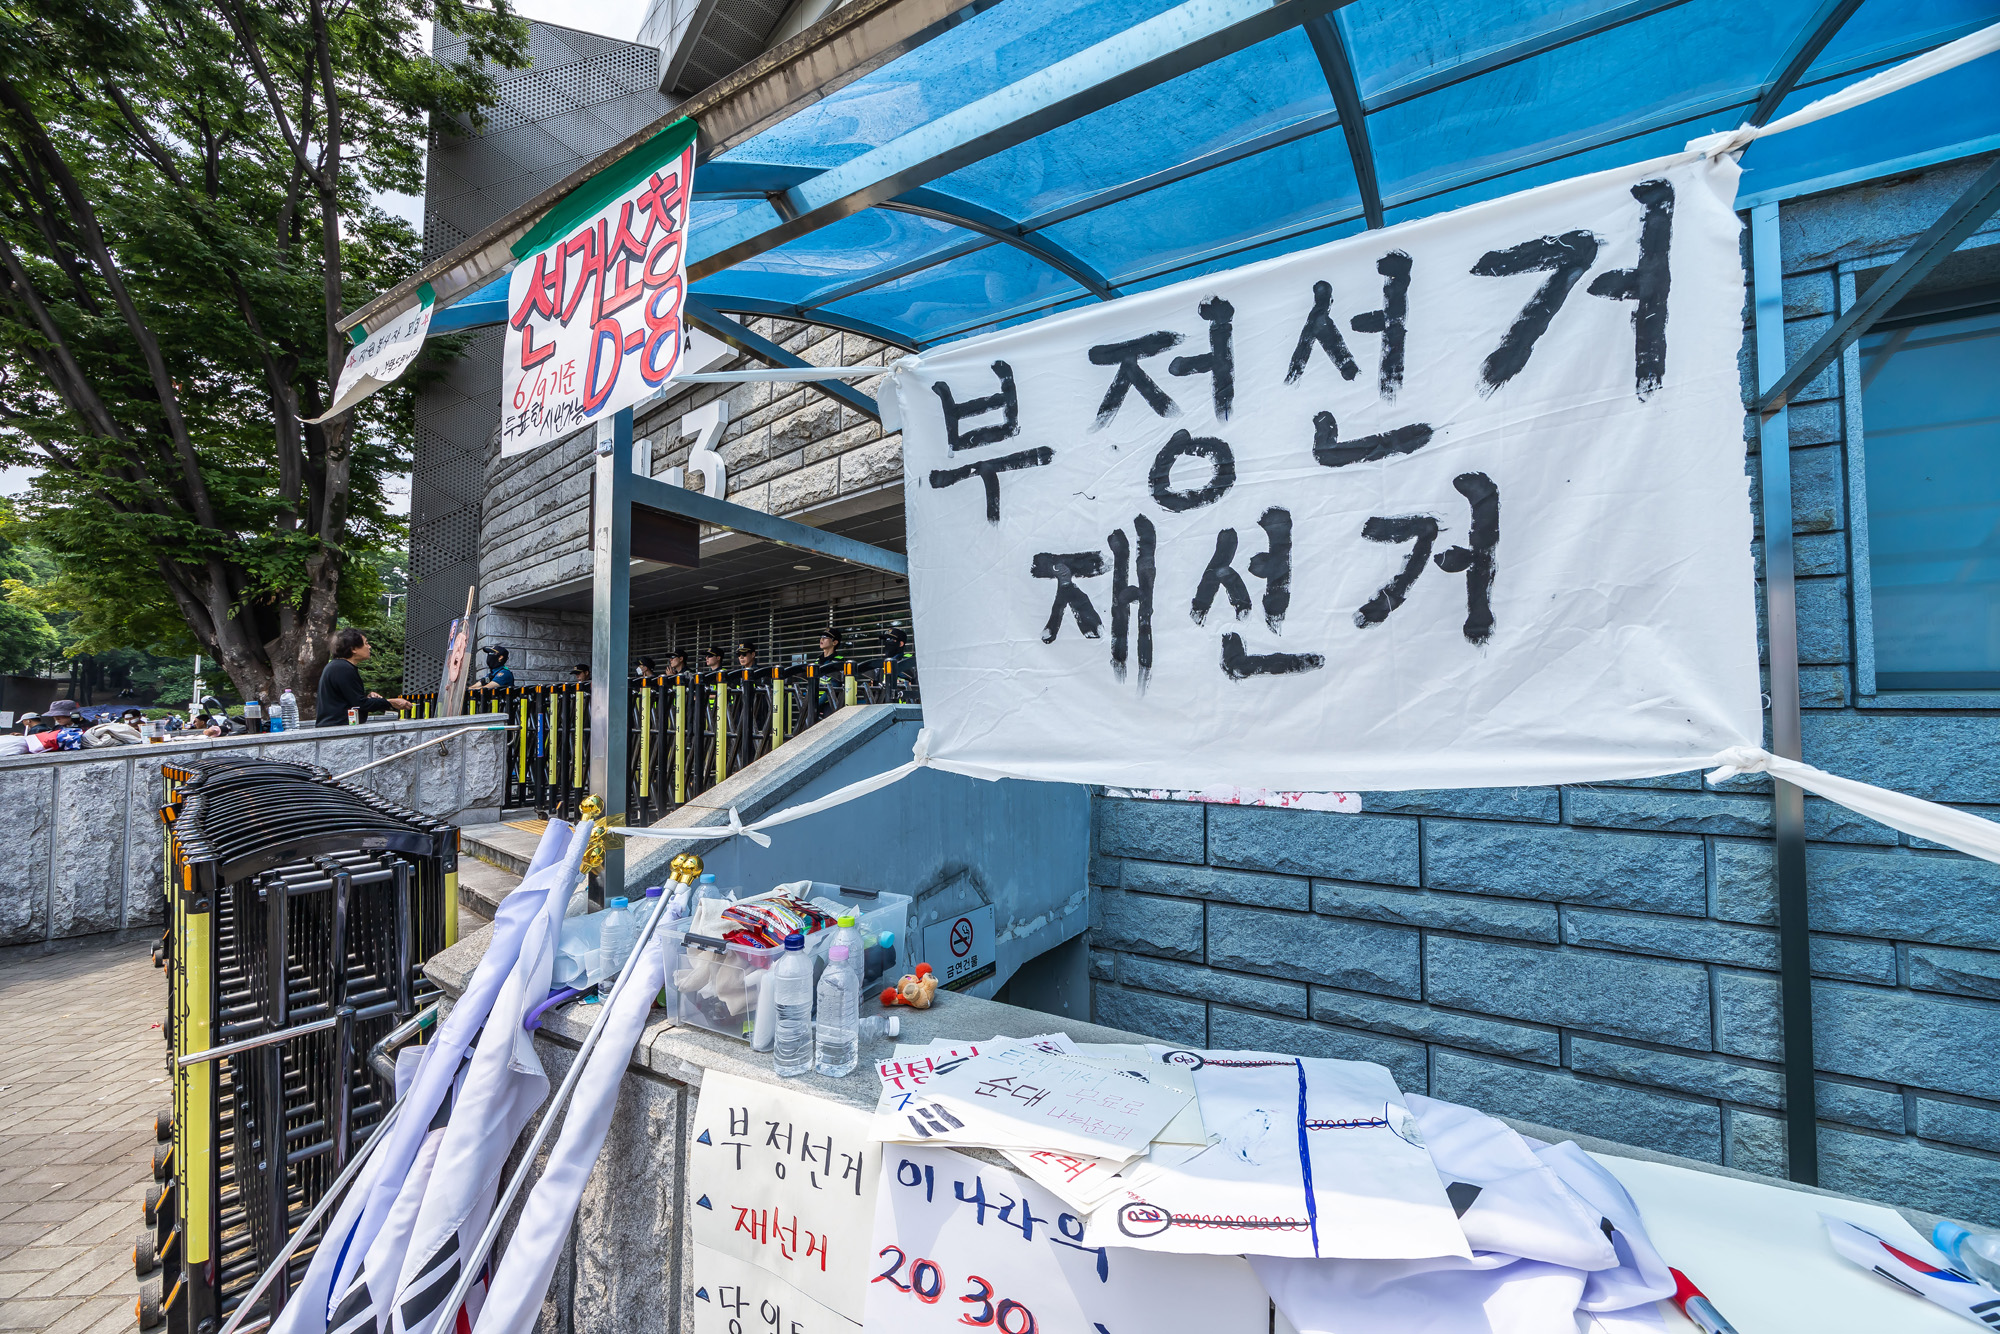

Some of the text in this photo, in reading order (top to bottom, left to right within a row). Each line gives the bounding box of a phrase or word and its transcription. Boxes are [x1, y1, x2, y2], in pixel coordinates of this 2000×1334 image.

[510, 143, 694, 371] 선거소청
[583, 274, 682, 418] D-8
[928, 178, 1676, 525] 부정선거
[1031, 470, 1500, 696] 재선거
[947, 955, 978, 979] 금연건물
[975, 1076, 1051, 1107] 순대
[720, 1107, 863, 1196] 부정선거
[731, 1204, 827, 1272] 재선거
